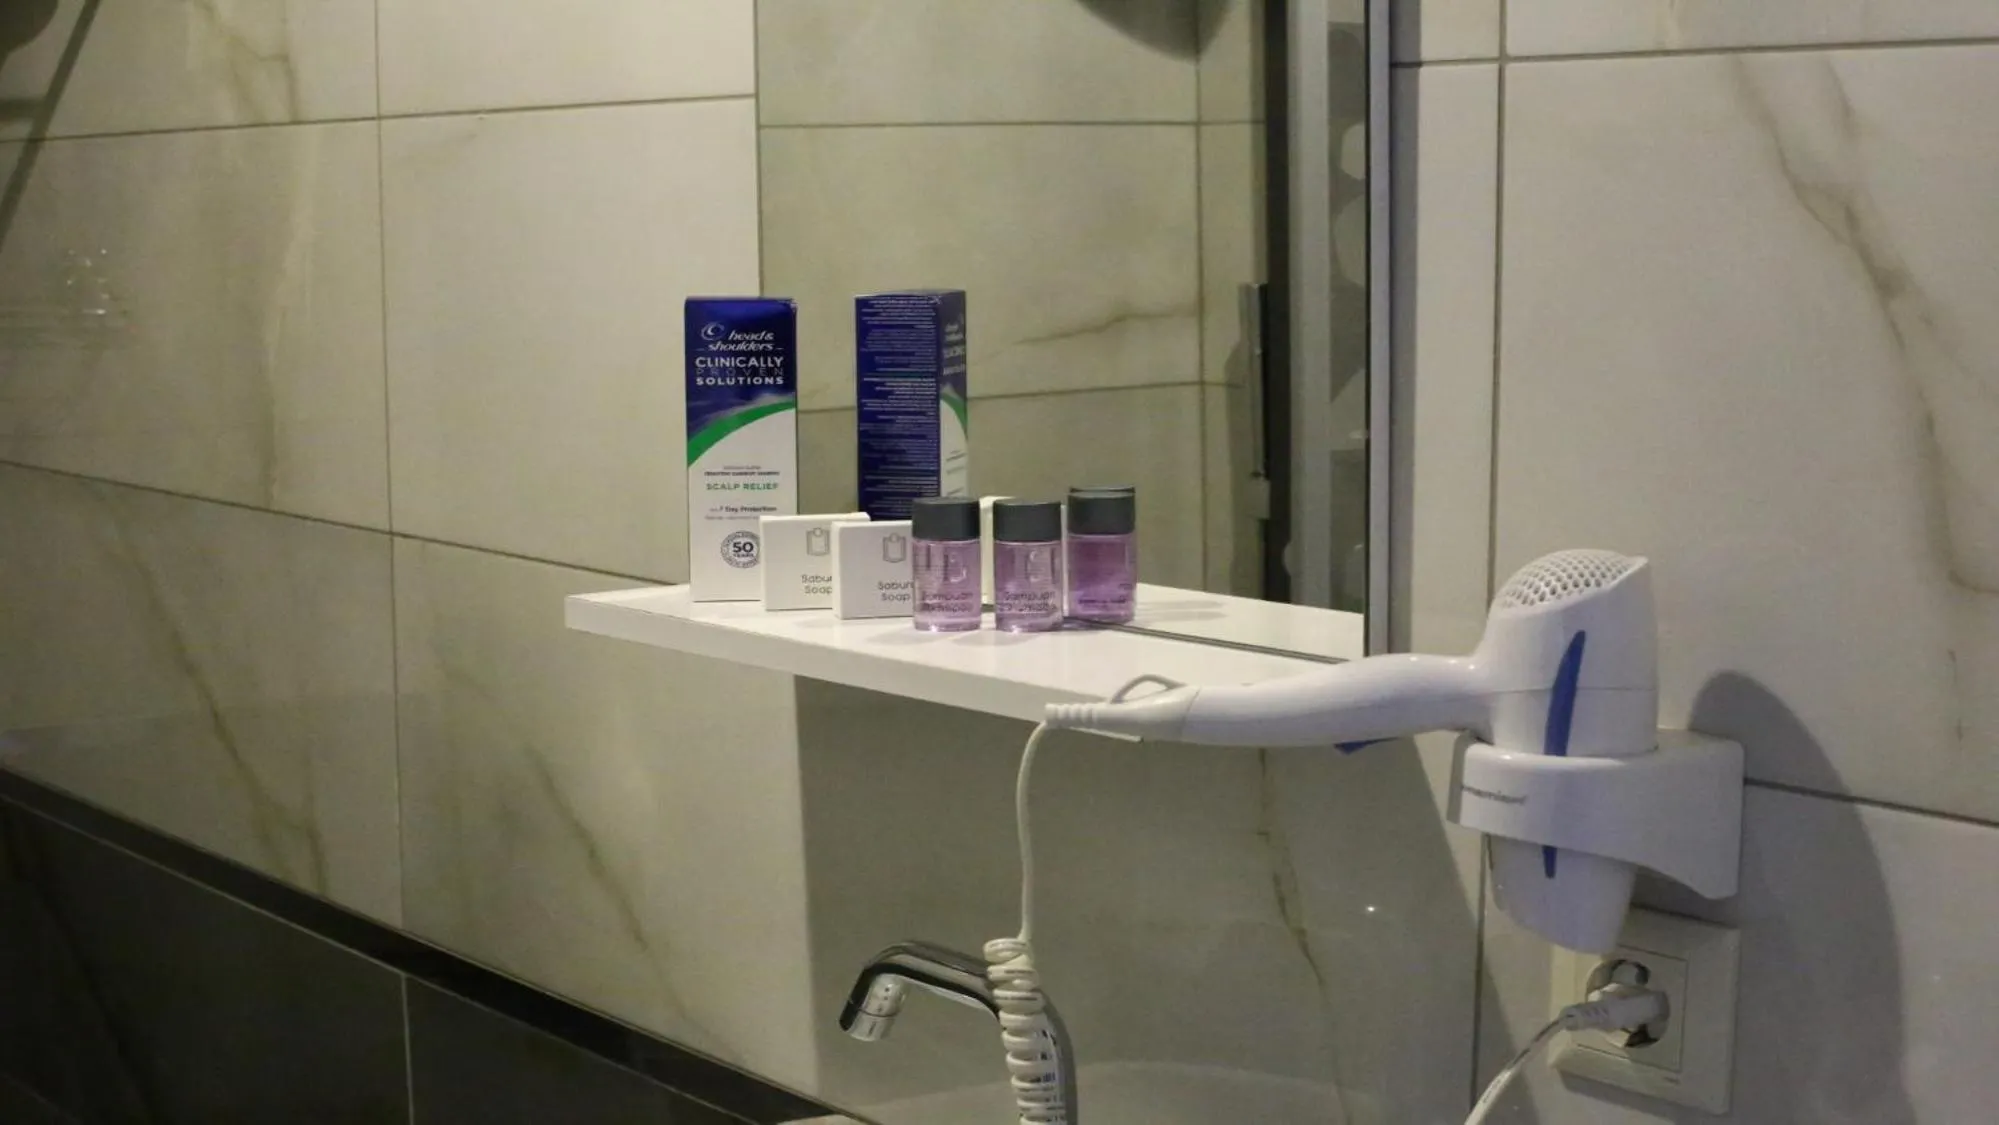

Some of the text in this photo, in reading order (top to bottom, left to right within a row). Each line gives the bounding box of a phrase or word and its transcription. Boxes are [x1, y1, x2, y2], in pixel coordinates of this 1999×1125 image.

[708, 341, 775, 352] shoulders
[695, 356, 784, 368] CLINICALLY
[696, 368, 783, 377] PROVEN
[696, 377, 784, 385] SOLUTIONS
[733, 541, 754, 553] 50
[881, 593, 911, 603] Soap
